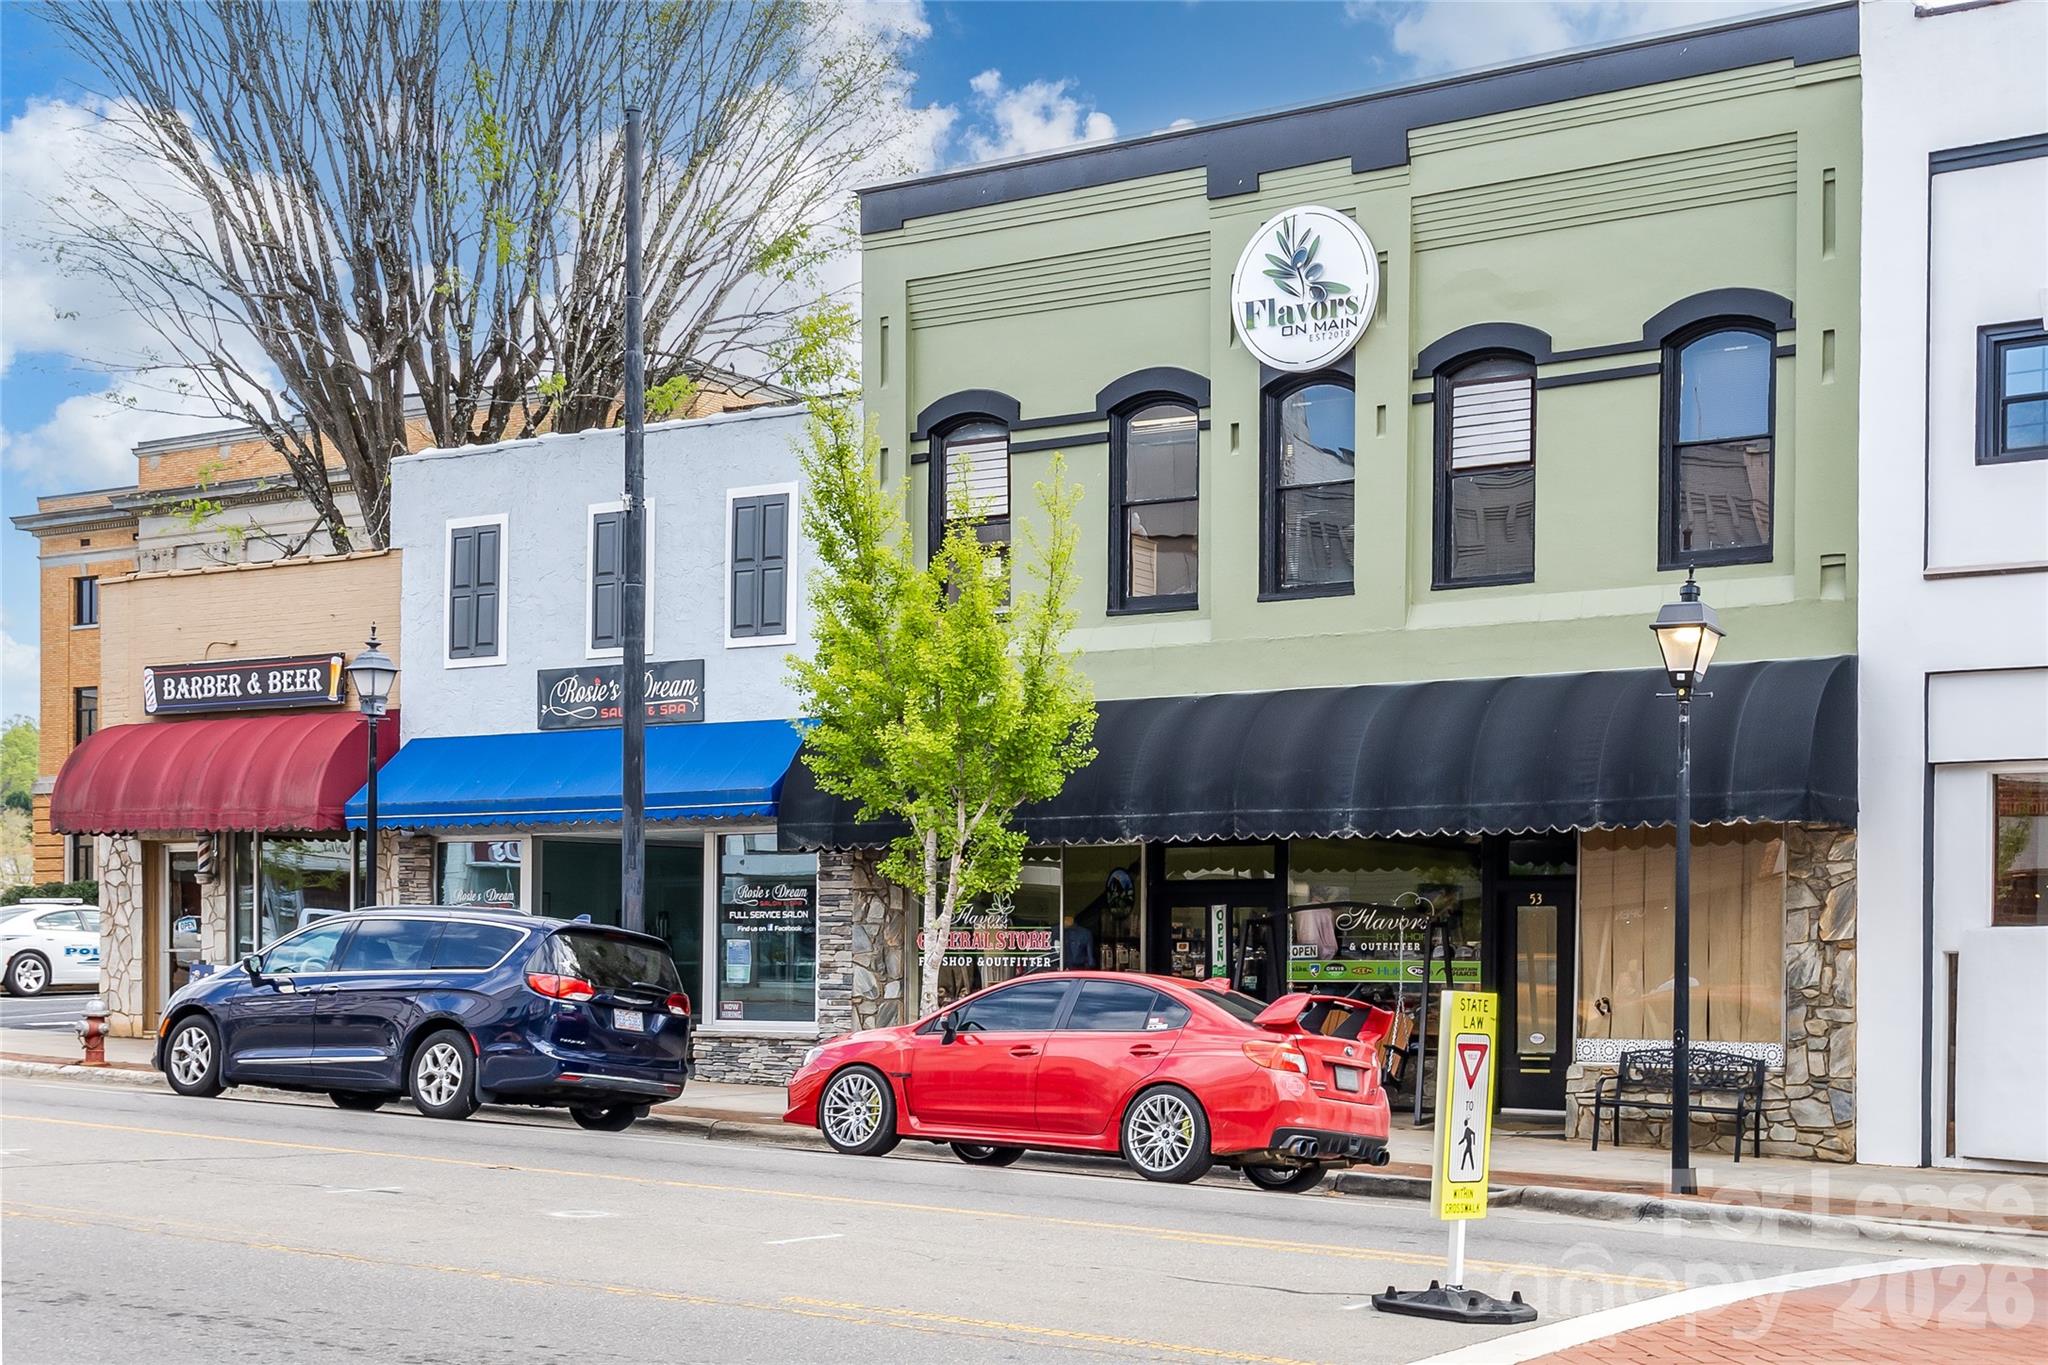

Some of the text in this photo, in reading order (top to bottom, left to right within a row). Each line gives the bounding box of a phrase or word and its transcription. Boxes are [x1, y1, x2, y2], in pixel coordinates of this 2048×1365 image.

[1244, 295, 1359, 330] Flavors
[1281, 316, 1358, 337] ON MAIN
[1309, 329, 1350, 342] EST 2018
[163, 668, 323, 700] BARBER & BEER
[551, 674, 622, 704] Rosie's
[601, 703, 687, 719] SAL & SPA
[454, 889, 482, 902] Rosies
[734, 883, 808, 899] Rosies Dream
[1529, 893, 1543, 905] 53
[729, 910, 809, 919] FULL SERVICE SALON
[950, 903, 1009, 925] Flavors
[1336, 907, 1427, 931] Flavors
[774, 924, 802, 932] Facebook
[995, 931, 1053, 950] STORE
[1215, 909, 1224, 961] OPEN
[1292, 946, 1317, 957] OPEN
[1349, 942, 1420, 951] & OUTFITTER
[942, 957, 973, 967] SHOP
[1460, 998, 1488, 1012] STATE
[1463, 1016, 1484, 1029] LAW
[1465, 1101, 1474, 1111] TO
[1454, 1188, 1473, 1199] WITHIN
[1445, 1203, 1480, 1213] CROSSWALK
